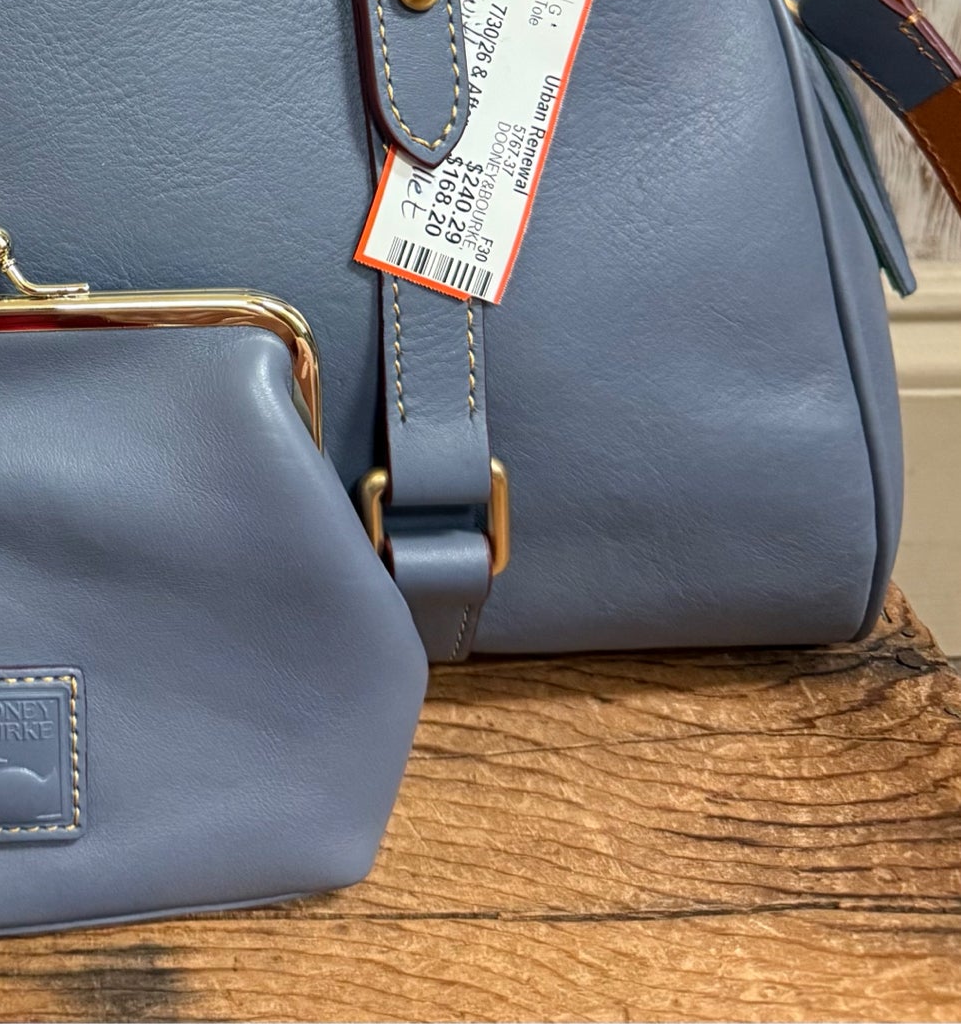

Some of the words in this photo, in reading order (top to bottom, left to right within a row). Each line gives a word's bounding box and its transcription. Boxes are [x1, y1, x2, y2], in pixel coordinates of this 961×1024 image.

[476, 3, 508, 64] 7/30/26
[470, 65, 488, 79] &
[533, 74, 561, 121] Urban
[503, 123, 527, 178] 5767-37
[513, 124, 547, 196] Renewal
[424, 153, 464, 237] $168.20
[445, 160, 484, 245] $240.29
[474, 236, 494, 263] F30
